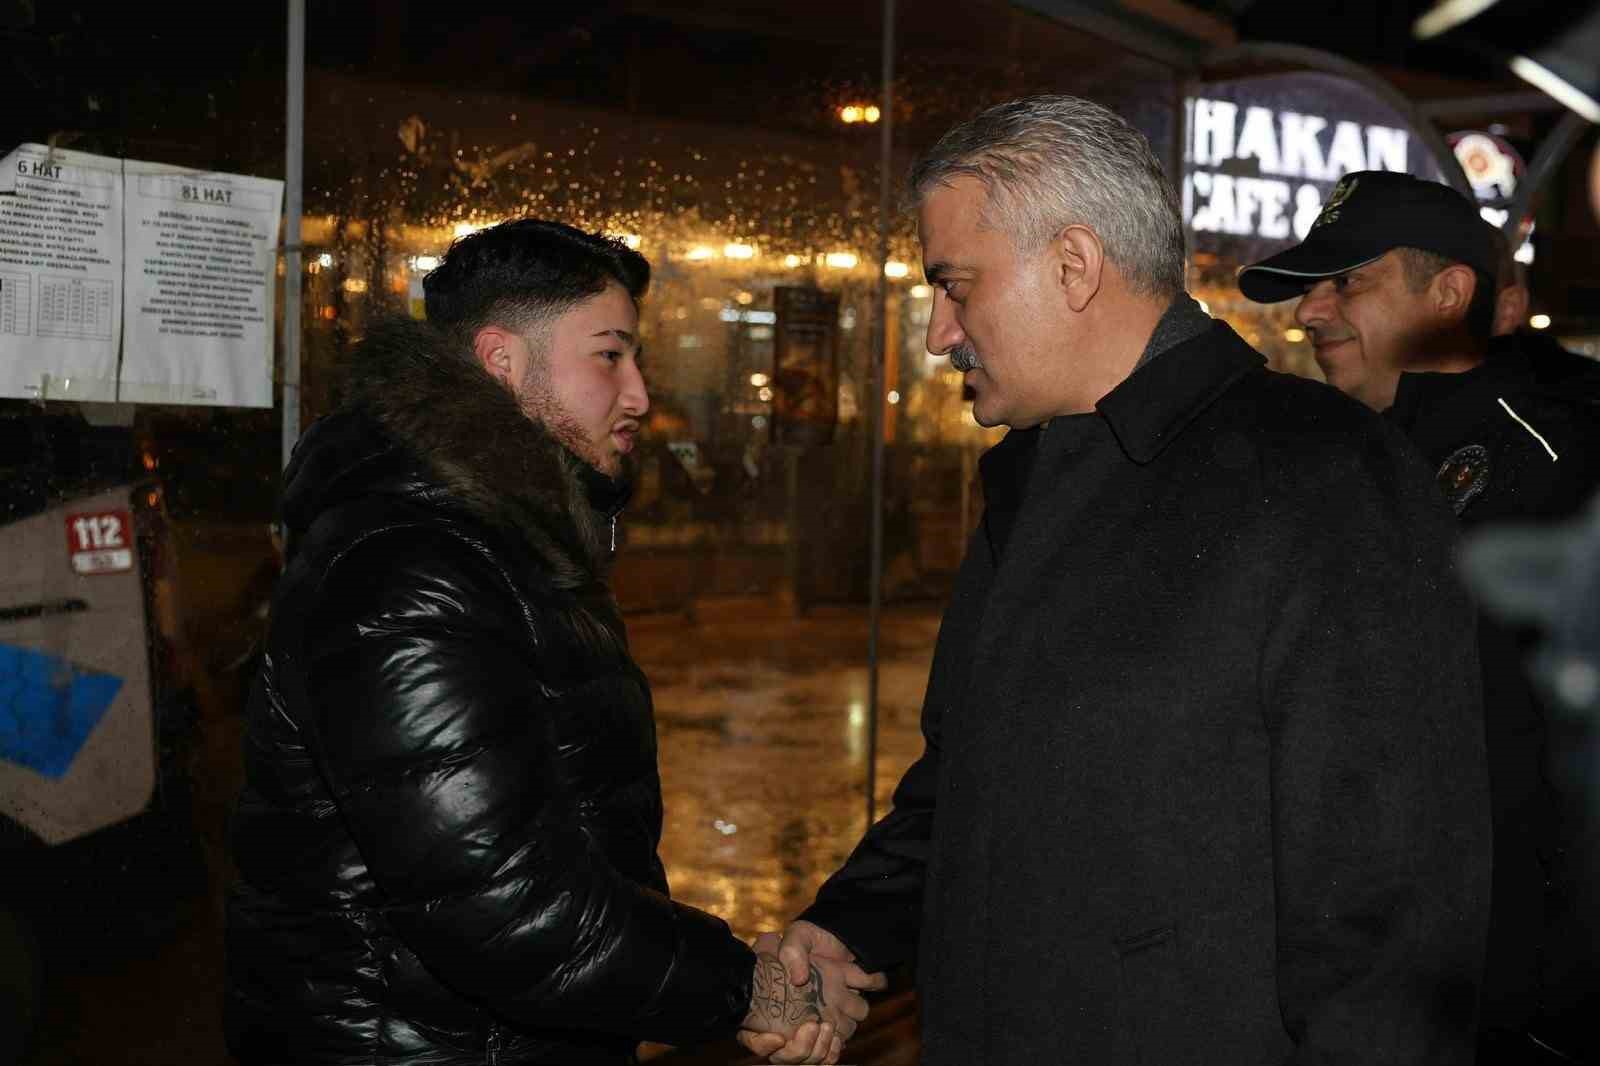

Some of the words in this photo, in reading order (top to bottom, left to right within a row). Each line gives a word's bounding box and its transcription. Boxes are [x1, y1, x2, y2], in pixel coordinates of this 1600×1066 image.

[1185, 98, 1409, 182] HAKAN
[17, 160, 28, 174] 6
[32, 162, 62, 179] HAT
[181, 184, 200, 201] 81
[204, 188, 233, 203] HAT
[1183, 171, 1291, 240] CAFE
[74, 515, 123, 549] 112
